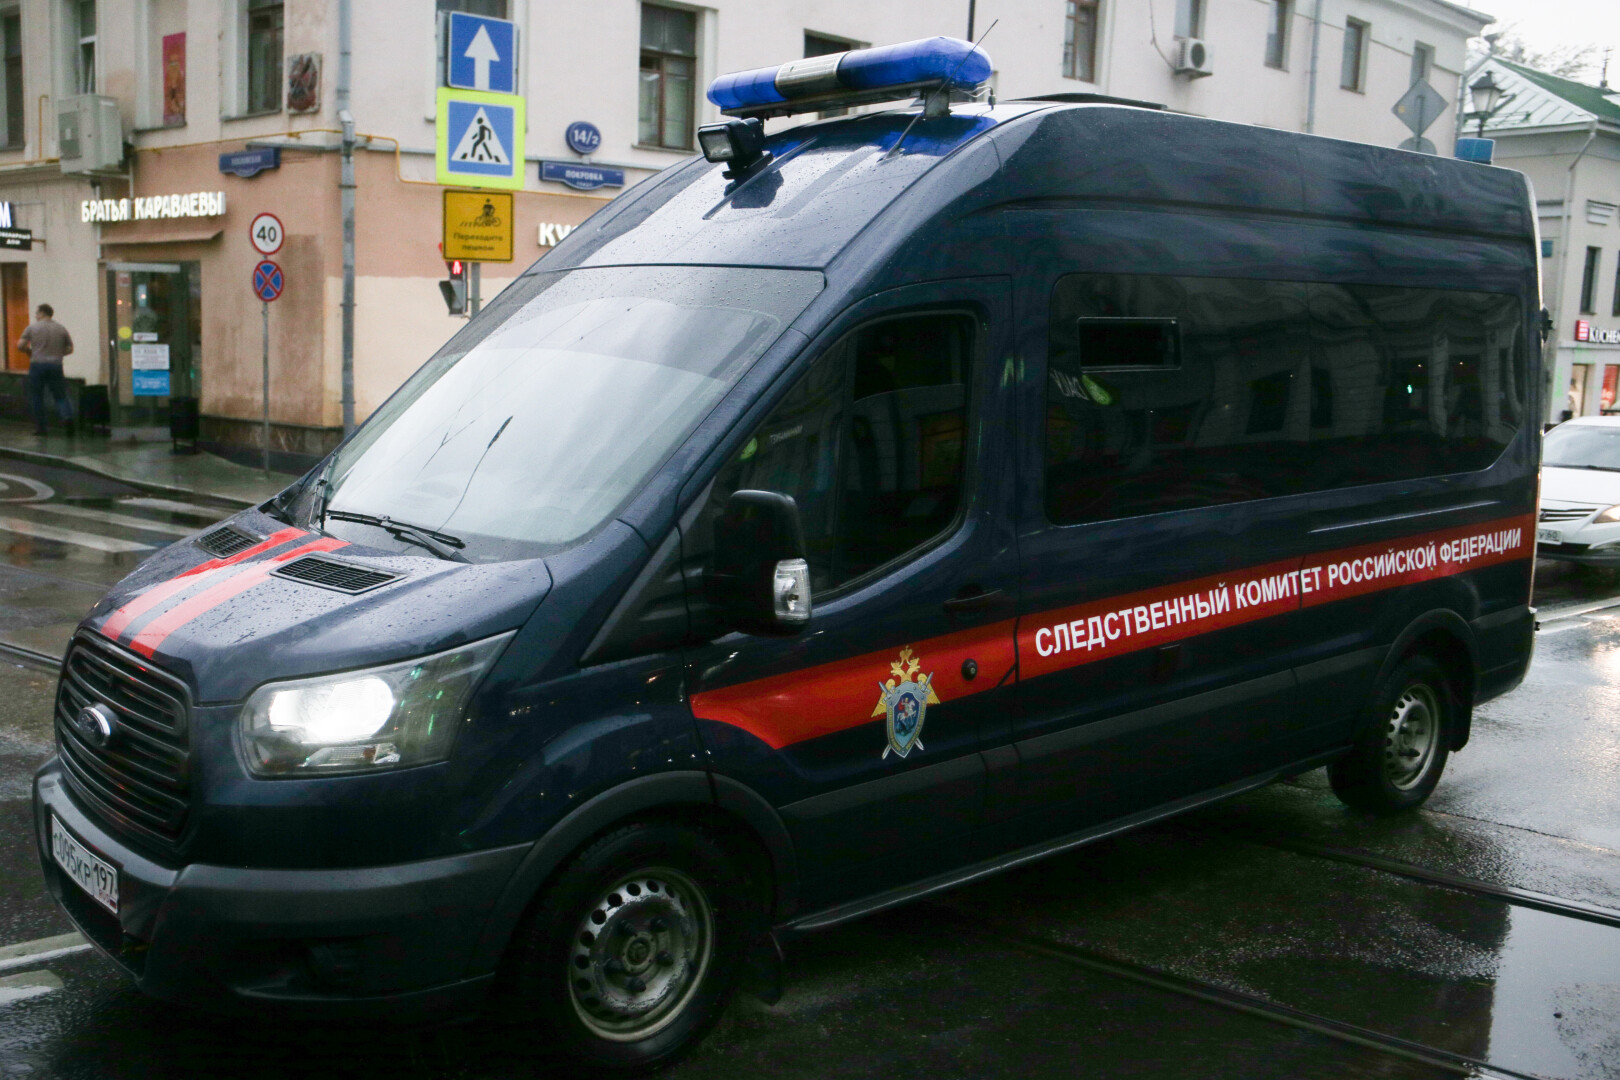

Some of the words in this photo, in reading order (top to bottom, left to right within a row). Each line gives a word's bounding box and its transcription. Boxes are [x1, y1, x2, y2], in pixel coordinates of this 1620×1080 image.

[573, 129, 599, 145] 14/2
[81, 198, 129, 222] БРАТЬЯ
[135, 191, 223, 220] КАРАВАЕВЫ
[256, 226, 277, 242] 40
[538, 222, 579, 247] КУ
[1035, 582, 1230, 657] СЛЕДСТВЕННЫЙ
[1235, 567, 1322, 608] КОМИТЕТ
[1328, 541, 1437, 588] РОССИЙСКОЙ
[1440, 528, 1521, 564] ФЕДЕРАЦИИ
